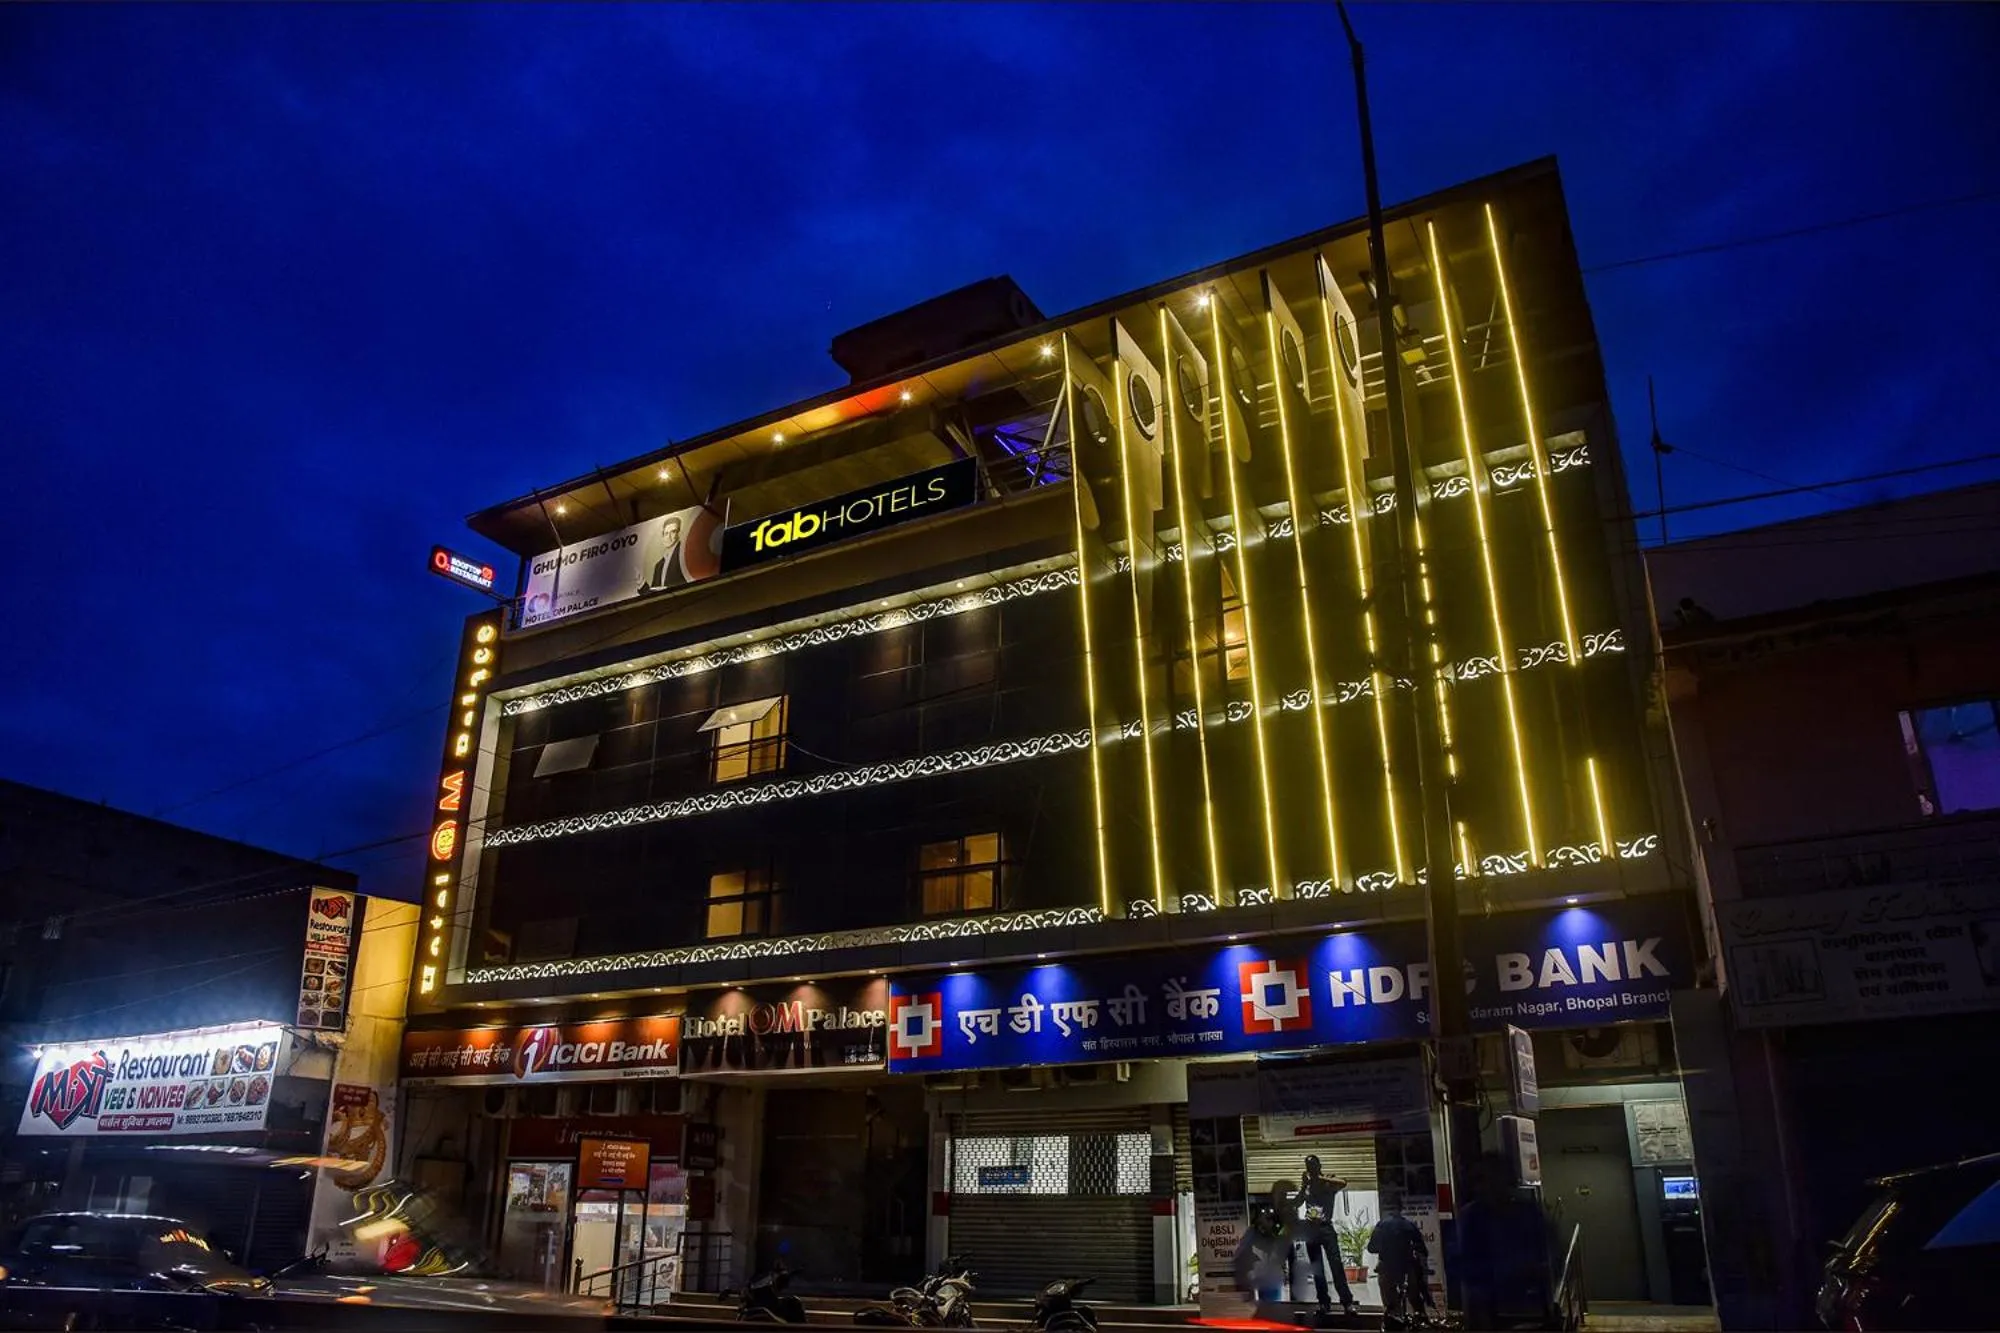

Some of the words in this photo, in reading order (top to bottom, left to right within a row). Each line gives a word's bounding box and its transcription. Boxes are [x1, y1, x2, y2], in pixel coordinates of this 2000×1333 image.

[579, 543, 609, 562] FIRO
[611, 533, 639, 551] OYO
[567, 597, 600, 613] PALACE
[1496, 937, 1671, 992] BANK
[958, 1008, 1001, 1045] एच
[1008, 993, 1044, 1034] डी
[1050, 999, 1100, 1038] एफ
[1107, 983, 1149, 1027] सी
[1162, 975, 1221, 1020] बैंक
[1517, 1001, 1563, 1017] Nagar,
[1566, 993, 1618, 1011] Bhopal
[682, 1012, 746, 1041] Hotel
[748, 1000, 804, 1036] OM
[804, 1006, 886, 1032] Palace
[116, 1048, 210, 1080] Restaurant
[549, 1041, 606, 1065] ICICI
[608, 1038, 671, 1062] Bank
[104, 1087, 126, 1110] VEG
[127, 1087, 137, 1110] &
[137, 1085, 186, 1109] NONVEG
